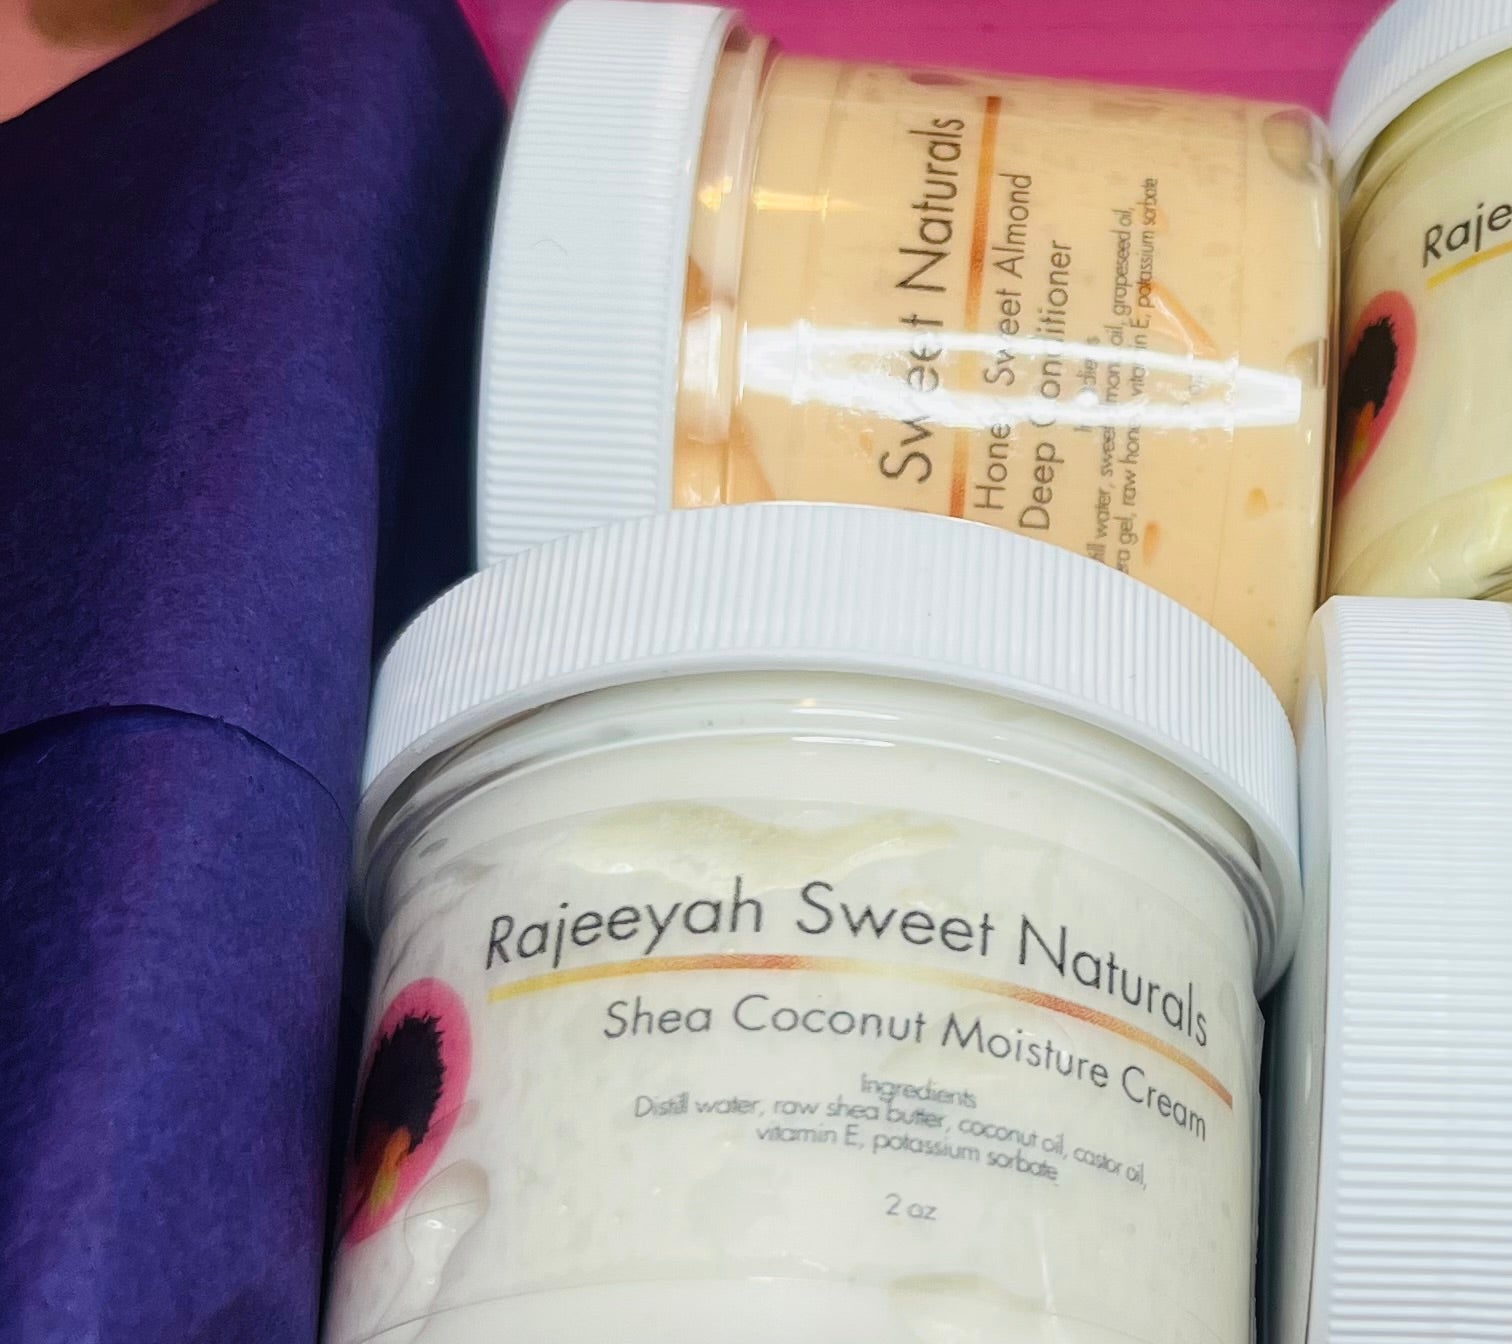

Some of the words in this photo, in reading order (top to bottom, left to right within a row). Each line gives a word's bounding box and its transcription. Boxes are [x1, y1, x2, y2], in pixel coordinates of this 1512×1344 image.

[896, 117, 965, 292] Naturals
[992, 173, 1032, 278] Almond
[1110, 230, 1132, 316] grapeseed
[1020, 442, 1065, 532] Deep
[485, 875, 764, 970] Rajeeyah
[795, 880, 995, 957] Sweet
[1018, 912, 1208, 1048] Naturals
[603, 995, 713, 1039] Shea
[732, 993, 927, 1044] Coconut
[940, 1011, 1110, 1089] Moisture
[1121, 1064, 1207, 1143] Cream
[860, 1072, 978, 1107] Ingredients
[756, 1123, 837, 1144] vitamin
[872, 1133, 981, 1162] potassium
[773, 1099, 820, 1116] raw
[826, 1093, 880, 1121] shea
[886, 1105, 952, 1133] butter,
[958, 1118, 1038, 1148] coconut
[1072, 1144, 1122, 1177] castor
[885, 1192, 902, 1217] 2
[906, 1201, 938, 1220] oz
